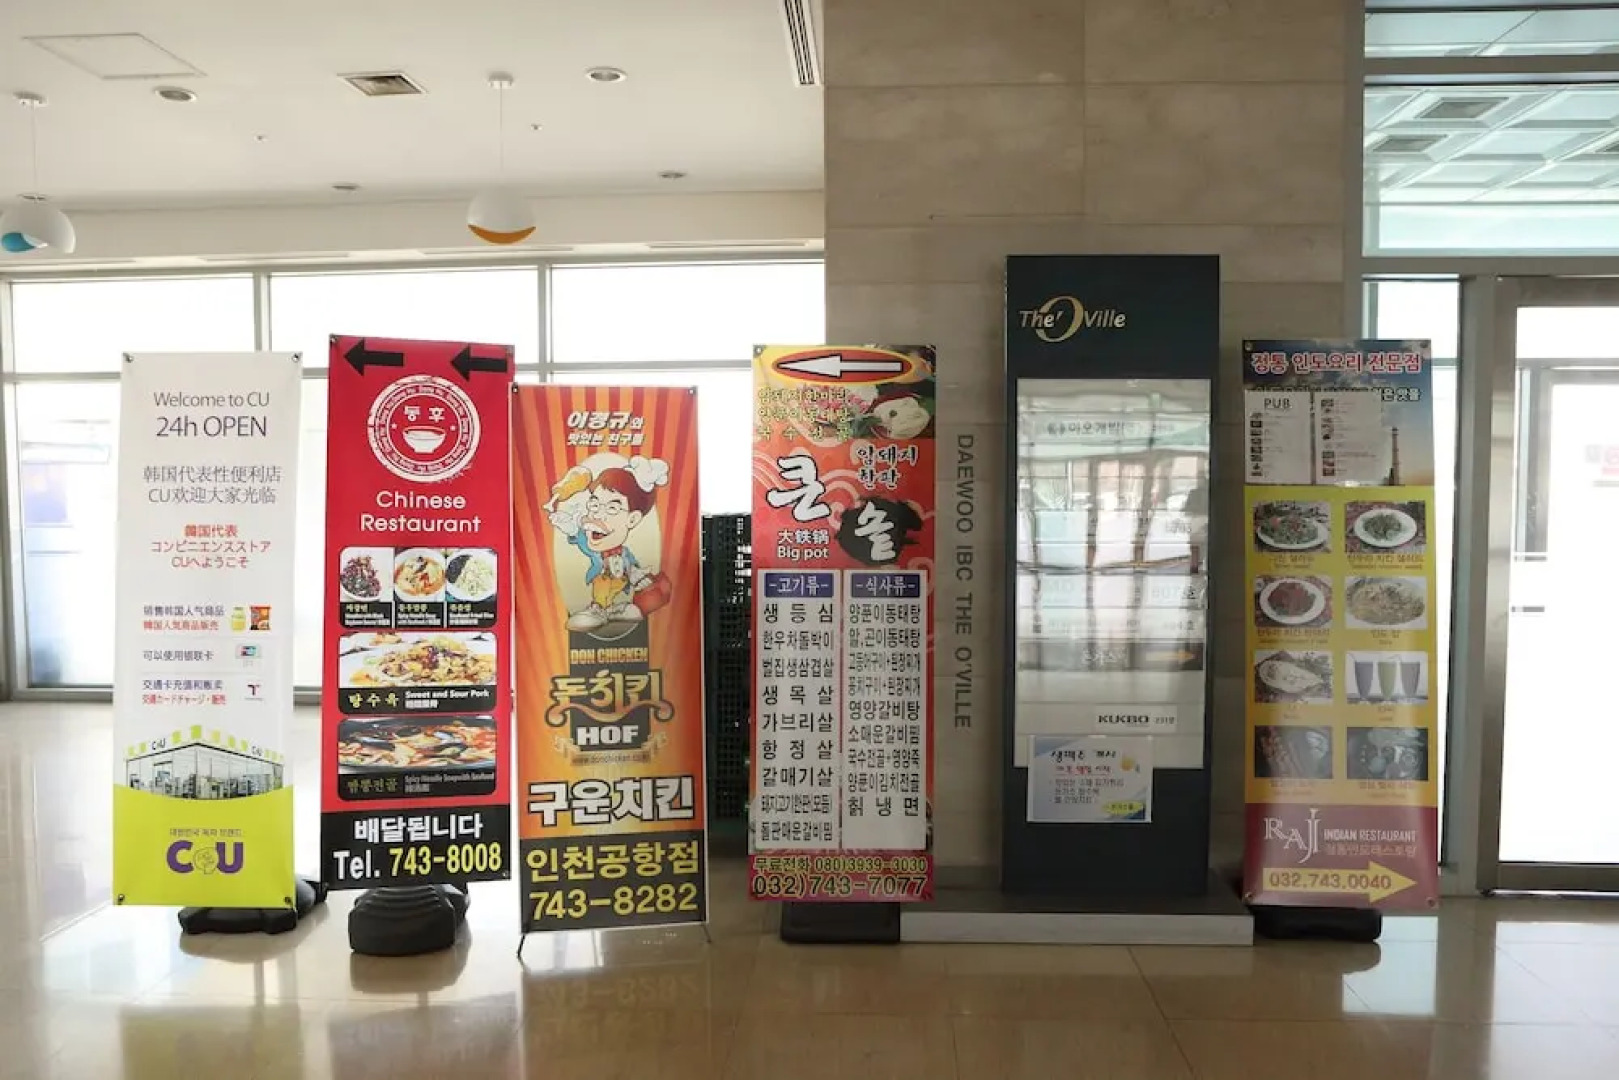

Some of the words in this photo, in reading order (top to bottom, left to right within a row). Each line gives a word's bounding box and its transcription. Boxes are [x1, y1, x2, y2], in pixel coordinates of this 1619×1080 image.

[1252, 351, 1289, 375] 정통
[1291, 351, 1363, 375] 인도요리
[1368, 351, 1423, 375] 전문점
[153, 391, 225, 407] Welcome
[229, 392, 244, 407] to
[247, 391, 270, 407] CU
[1264, 397, 1291, 409] PUB
[156, 415, 198, 437] 24h
[203, 415, 267, 437] OPEN
[567, 410, 644, 430] 이경규와
[567, 433, 604, 446] 맛있는
[143, 465, 282, 483] 韩国代表性便利店
[956, 434, 974, 534] DAEWOO
[766, 454, 831, 523] 큰
[376, 490, 466, 509] Chinese
[360, 513, 482, 532] Restaurant
[777, 529, 830, 544] 大铁锅
[171, 556, 249, 569] CUへようこそ
[777, 545, 801, 561] Big
[803, 546, 830, 561] pot
[956, 545, 974, 581] IBC
[955, 592, 973, 636] THE
[762, 630, 835, 651] 한우차돌박이
[571, 648, 596, 665] DON
[597, 647, 649, 663] CHICKEN
[762, 658, 834, 678] 벌집생삼겹살
[405, 690, 430, 699] Sweet
[432, 690, 448, 699] and
[450, 689, 469, 698] Sour
[471, 688, 490, 697] Pork
[954, 646, 972, 728] O'VILLE
[348, 692, 399, 708] 탕수육
[848, 700, 920, 721] 영양갈비탕
[761, 711, 834, 733] 가브리살
[1098, 715, 1149, 723] KUKBO
[576, 724, 639, 746] HOF
[761, 766, 834, 788] 갈매기살
[527, 775, 695, 828] 구운치킨
[354, 812, 484, 844] 배달됩니다
[1263, 808, 1322, 864] RAJ
[1323, 828, 1358, 841] INDIAN
[1359, 829, 1417, 843] RESTAURANT
[166, 840, 244, 874] CU
[333, 849, 381, 880] Tel.
[389, 841, 502, 877] 743-8008
[526, 839, 699, 883] 인천공항점
[753, 856, 810, 873] 무료전화
[752, 874, 927, 898] 032)743-7077
[1269, 872, 1392, 889] 032.743.0040
[529, 881, 698, 921] 743-8282
